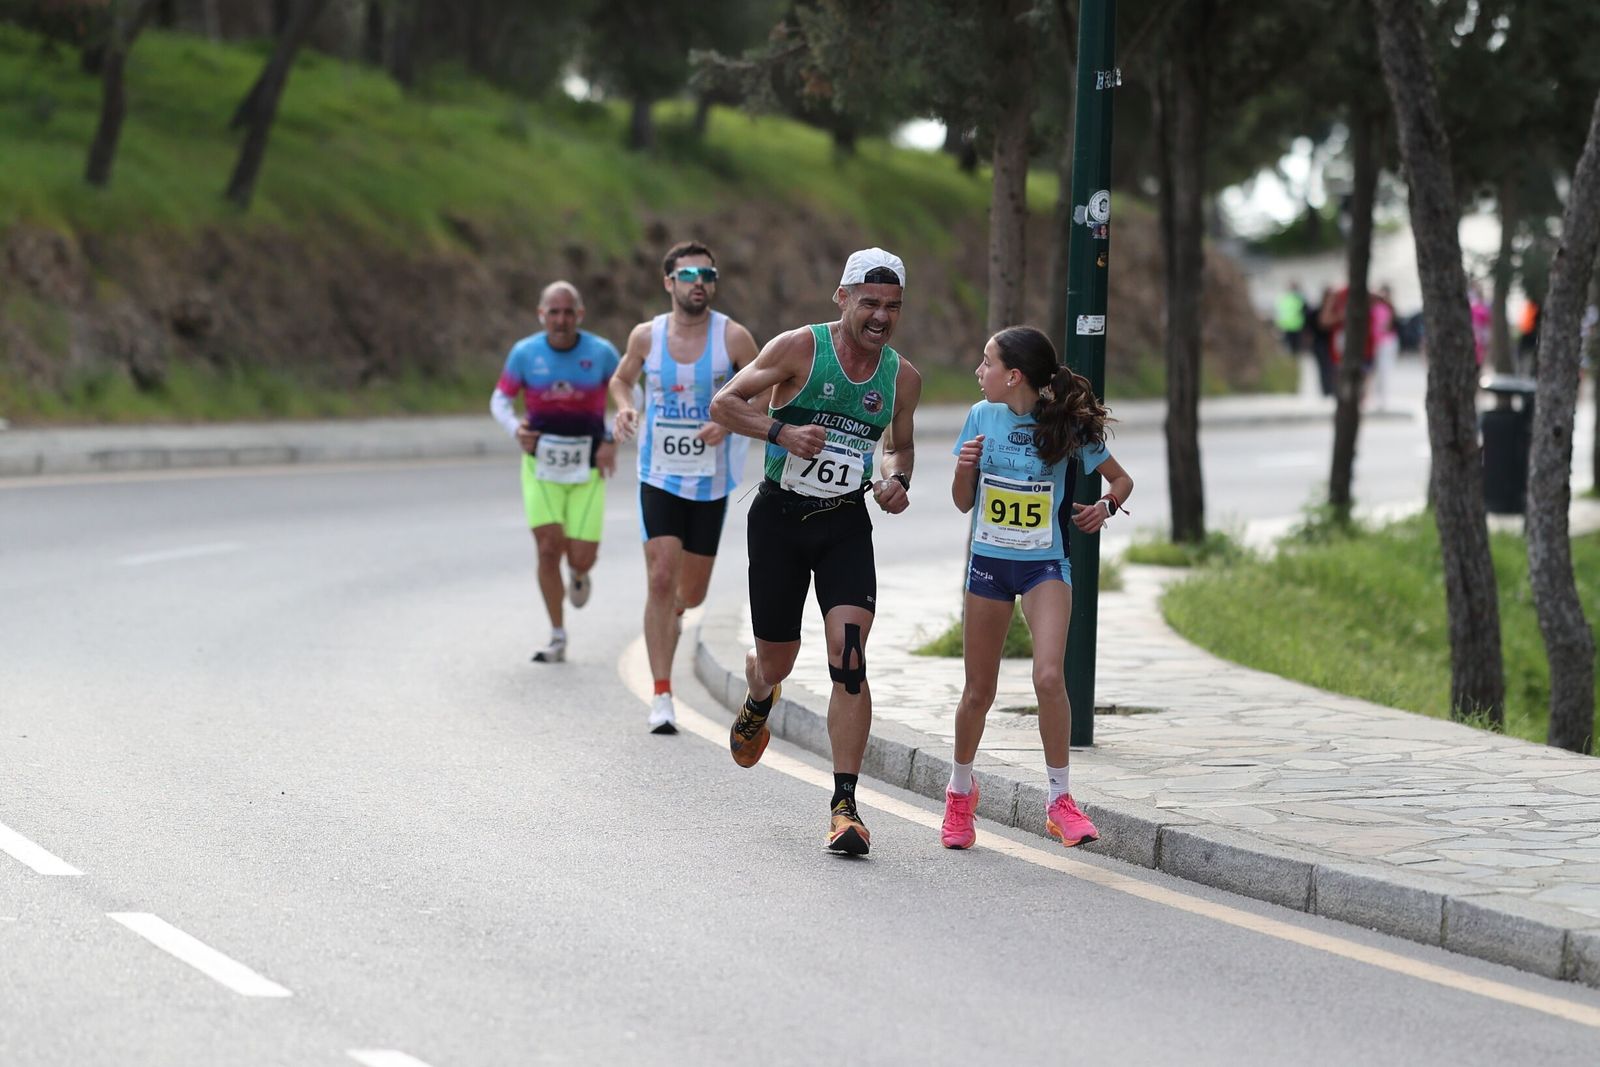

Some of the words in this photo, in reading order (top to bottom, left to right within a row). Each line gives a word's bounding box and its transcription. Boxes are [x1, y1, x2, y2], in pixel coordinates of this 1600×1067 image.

[811, 412, 871, 437] ATLETISMO
[663, 435, 706, 456] 669
[825, 431, 872, 451] MOLINOS
[1009, 432, 1031, 445] TROPS
[546, 450, 581, 467] 534
[800, 457, 850, 487] 761
[991, 498, 1041, 527] 915
